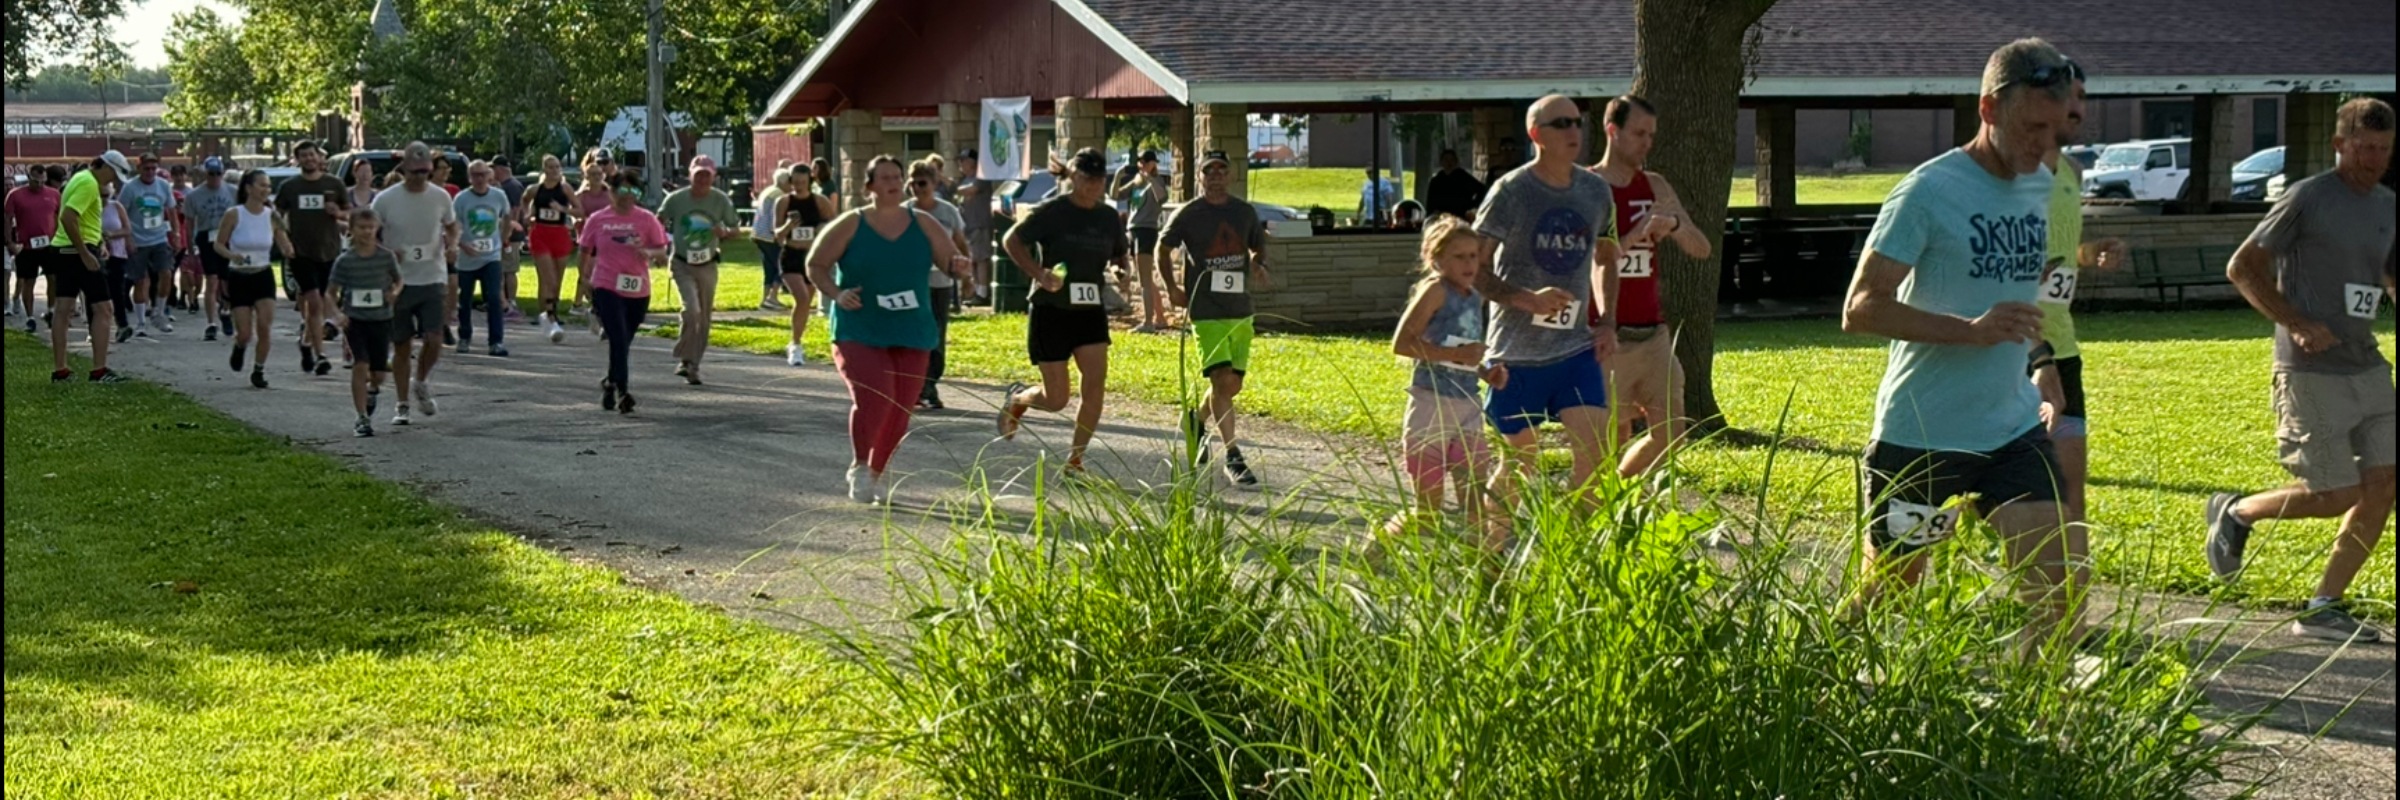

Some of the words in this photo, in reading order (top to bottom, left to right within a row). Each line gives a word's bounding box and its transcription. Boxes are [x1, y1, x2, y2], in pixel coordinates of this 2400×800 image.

[304, 197, 319, 207] 15
[1536, 234, 1587, 250] NASA
[414, 247, 422, 260] 3
[1620, 254, 1642, 274] 21
[622, 277, 638, 290] 30
[1224, 275, 1234, 290] 9
[2048, 272, 2074, 299] 32
[362, 292, 372, 304] 4
[887, 295, 910, 308] 11
[1078, 286, 1095, 302] 10
[2353, 290, 2373, 314] 29
[1907, 511, 1946, 541] 28
